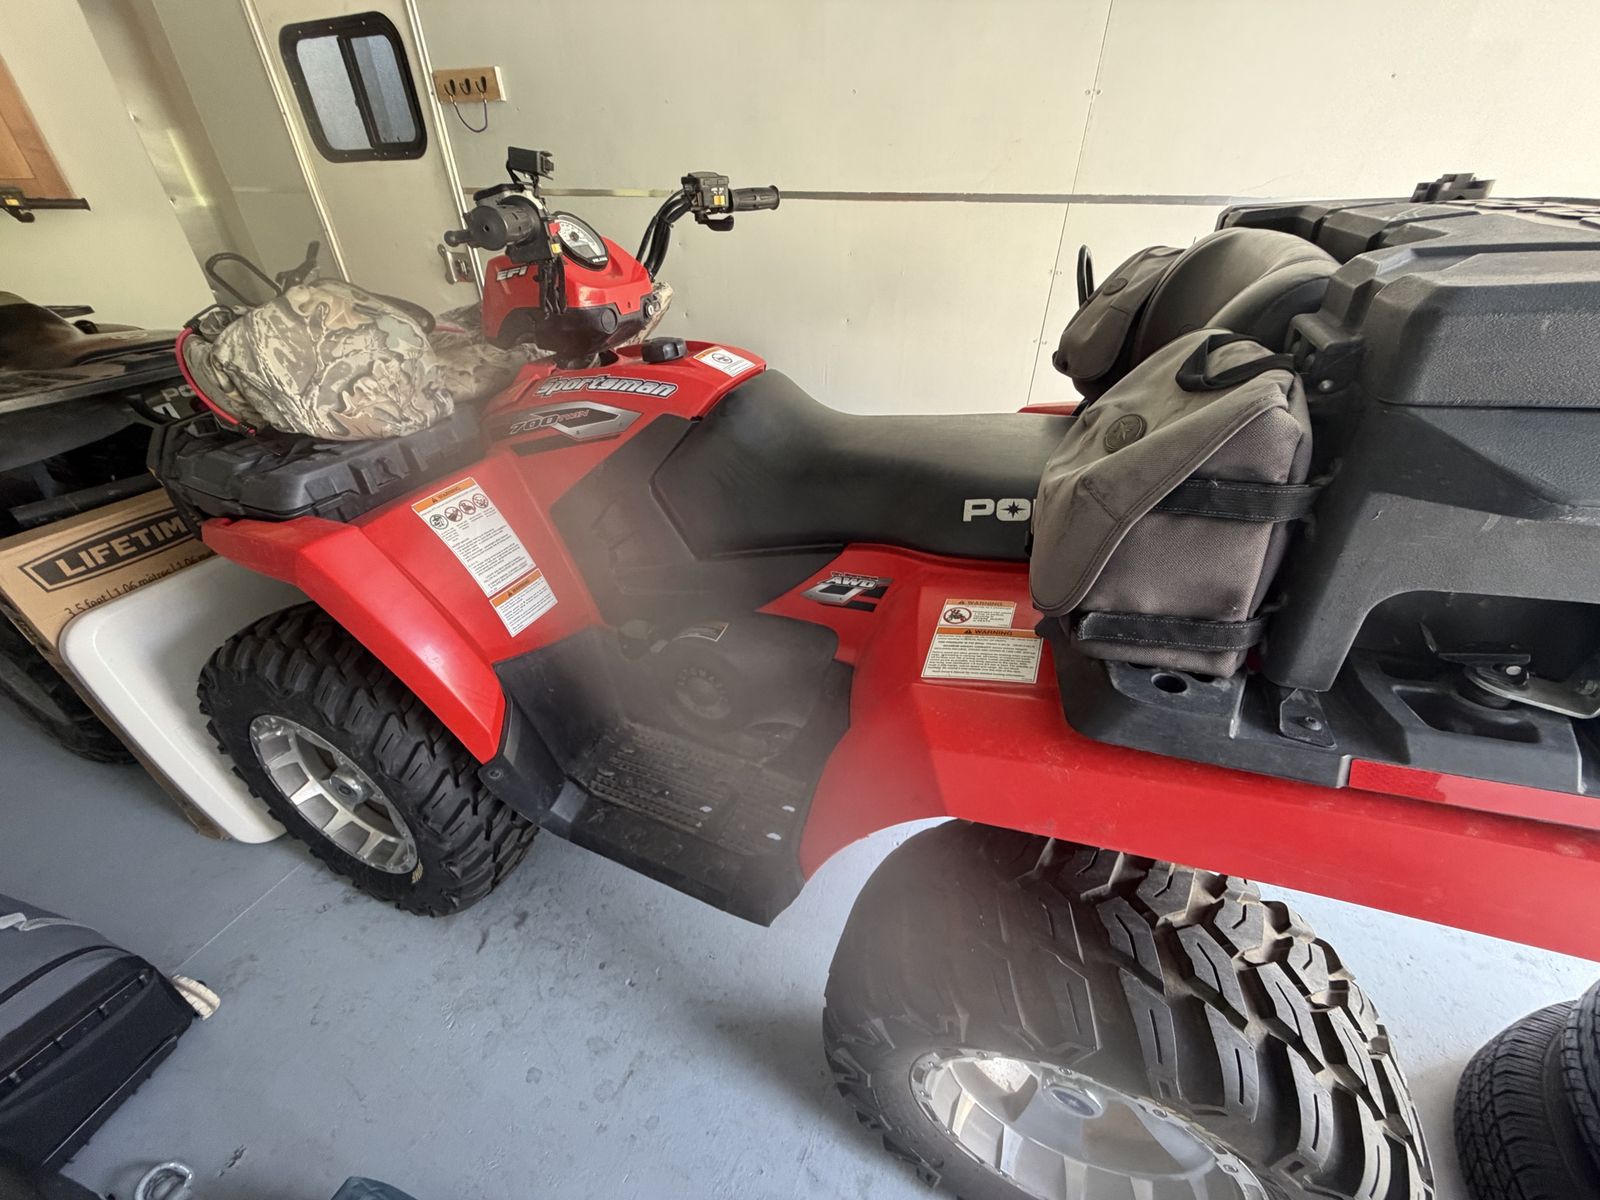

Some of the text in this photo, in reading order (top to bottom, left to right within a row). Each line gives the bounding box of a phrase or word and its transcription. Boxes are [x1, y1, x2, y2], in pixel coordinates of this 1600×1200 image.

[497, 266, 528, 280] EFI
[537, 375, 677, 398] Sportsman
[509, 414, 560, 434] 700
[963, 498, 1036, 521] PO
[55, 511, 200, 577] LIFETIM
[826, 577, 876, 588] AWD
